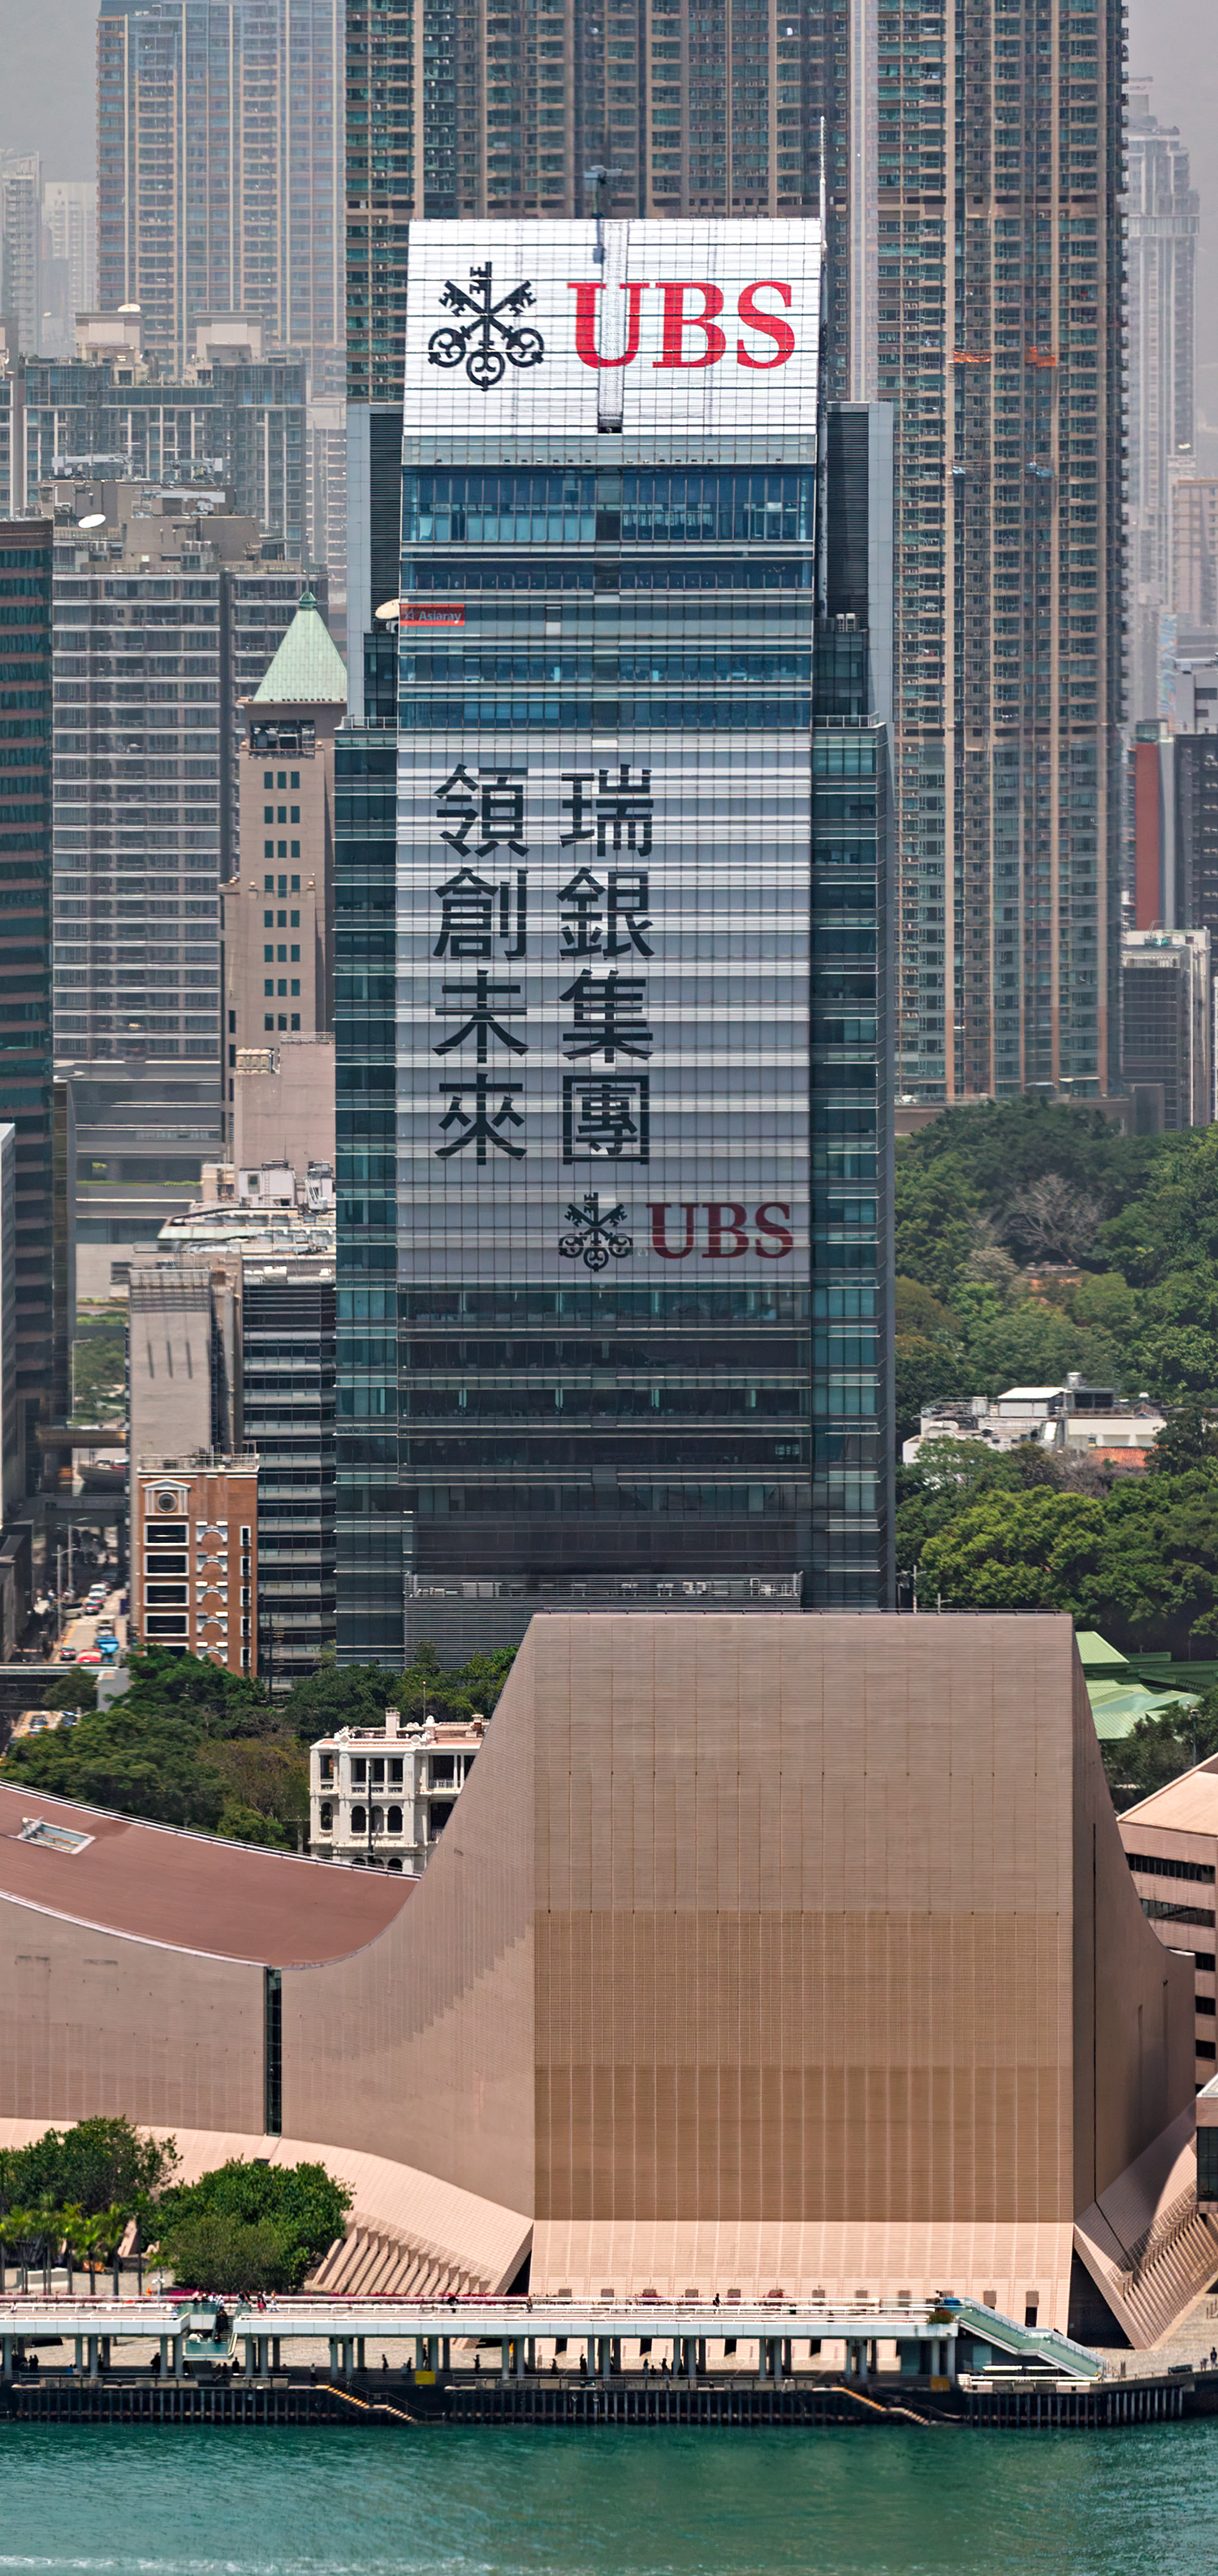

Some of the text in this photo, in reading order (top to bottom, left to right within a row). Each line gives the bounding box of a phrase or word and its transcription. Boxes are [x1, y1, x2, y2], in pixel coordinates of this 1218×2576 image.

[567, 280, 796, 370] UBS
[418, 611, 462, 624] Asiaray
[432, 763, 530, 1165] 領創未來
[556, 763, 655, 1165] 瑞銀集團
[646, 1202, 794, 1260] UBS
